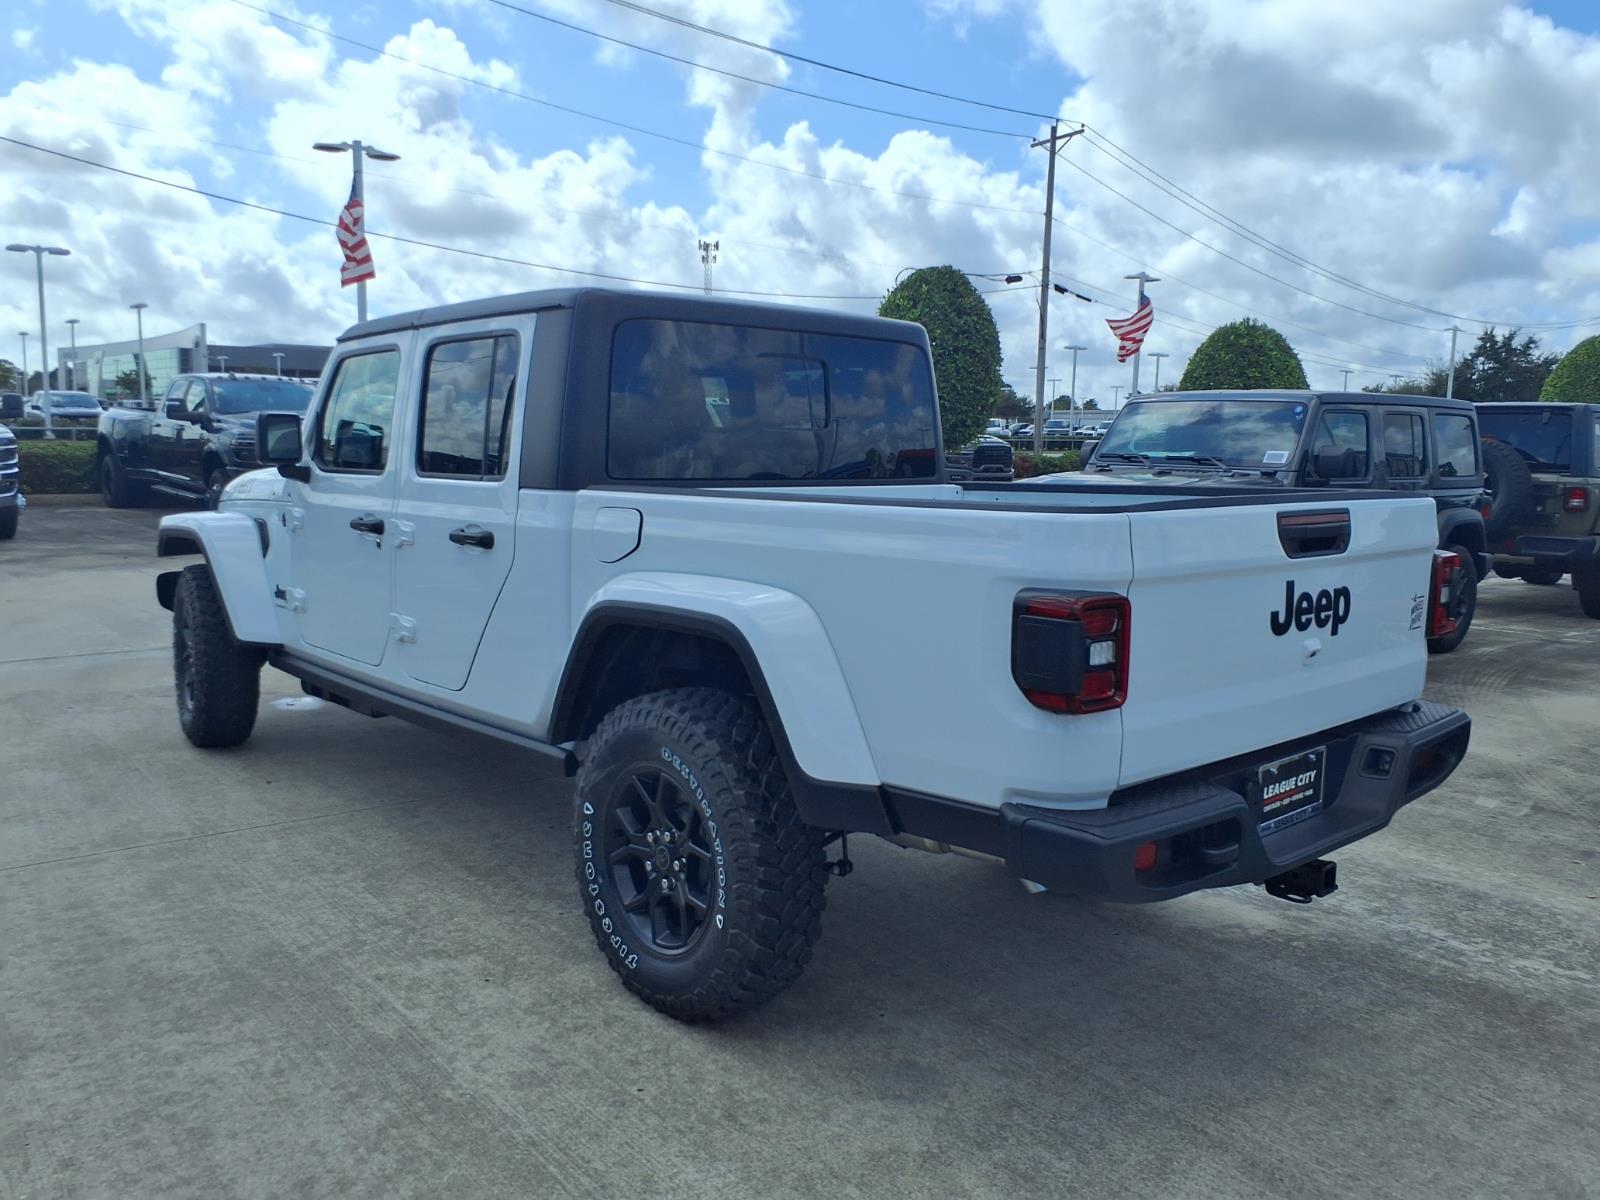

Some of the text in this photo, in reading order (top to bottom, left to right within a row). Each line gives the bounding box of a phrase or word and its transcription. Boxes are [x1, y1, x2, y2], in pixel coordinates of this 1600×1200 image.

[1270, 579, 1351, 637] Jeep
[1263, 770, 1317, 799] LEAGUE CITY
[661, 747, 726, 908] DESTINATION
